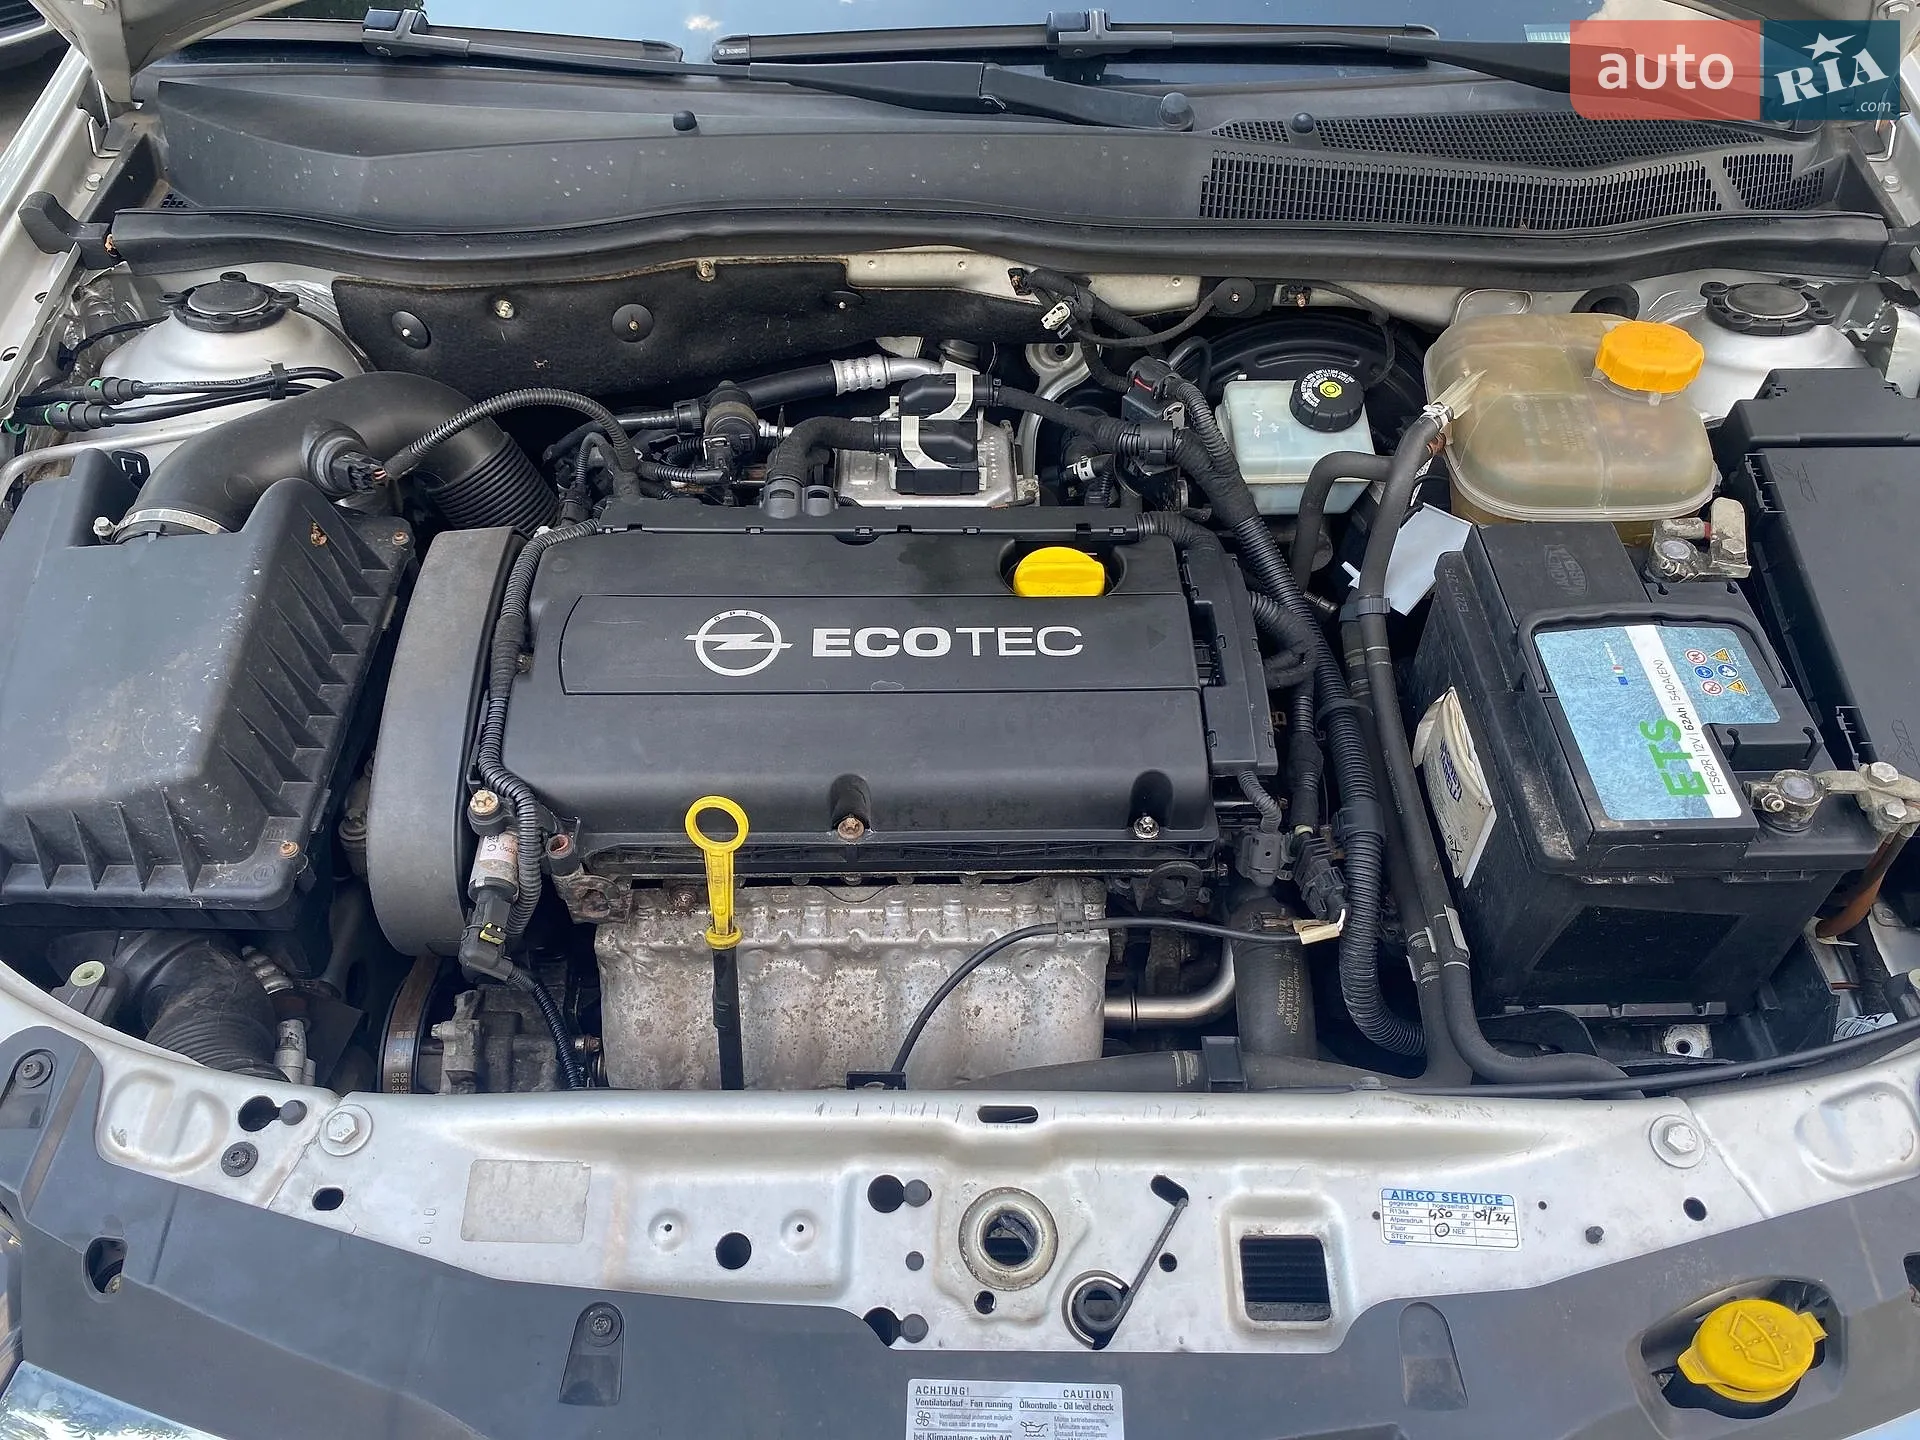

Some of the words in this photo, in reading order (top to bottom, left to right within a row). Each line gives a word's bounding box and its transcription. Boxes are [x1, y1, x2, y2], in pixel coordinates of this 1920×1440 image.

[714, 610, 765, 621] OPEL
[812, 626, 1084, 658] ECOTEC
[1676, 707, 1694, 731] 62Ah
[1640, 719, 1710, 796] ETS
[1391, 1190, 1435, 1201] AIRCO
[1441, 1192, 1503, 1205] SERVICE
[1428, 1208, 1453, 1220] 450
[915, 1385, 969, 1395] ACHTUNG!
[1063, 1389, 1114, 1399] CAUTION!
[915, 1398, 963, 1407] Ventilatorlauf
[984, 1401, 1012, 1409] running
[1019, 1399, 1057, 1409] Ölkontrolle
[1074, 1402, 1091, 1410] level
[1092, 1403, 1114, 1411] check
